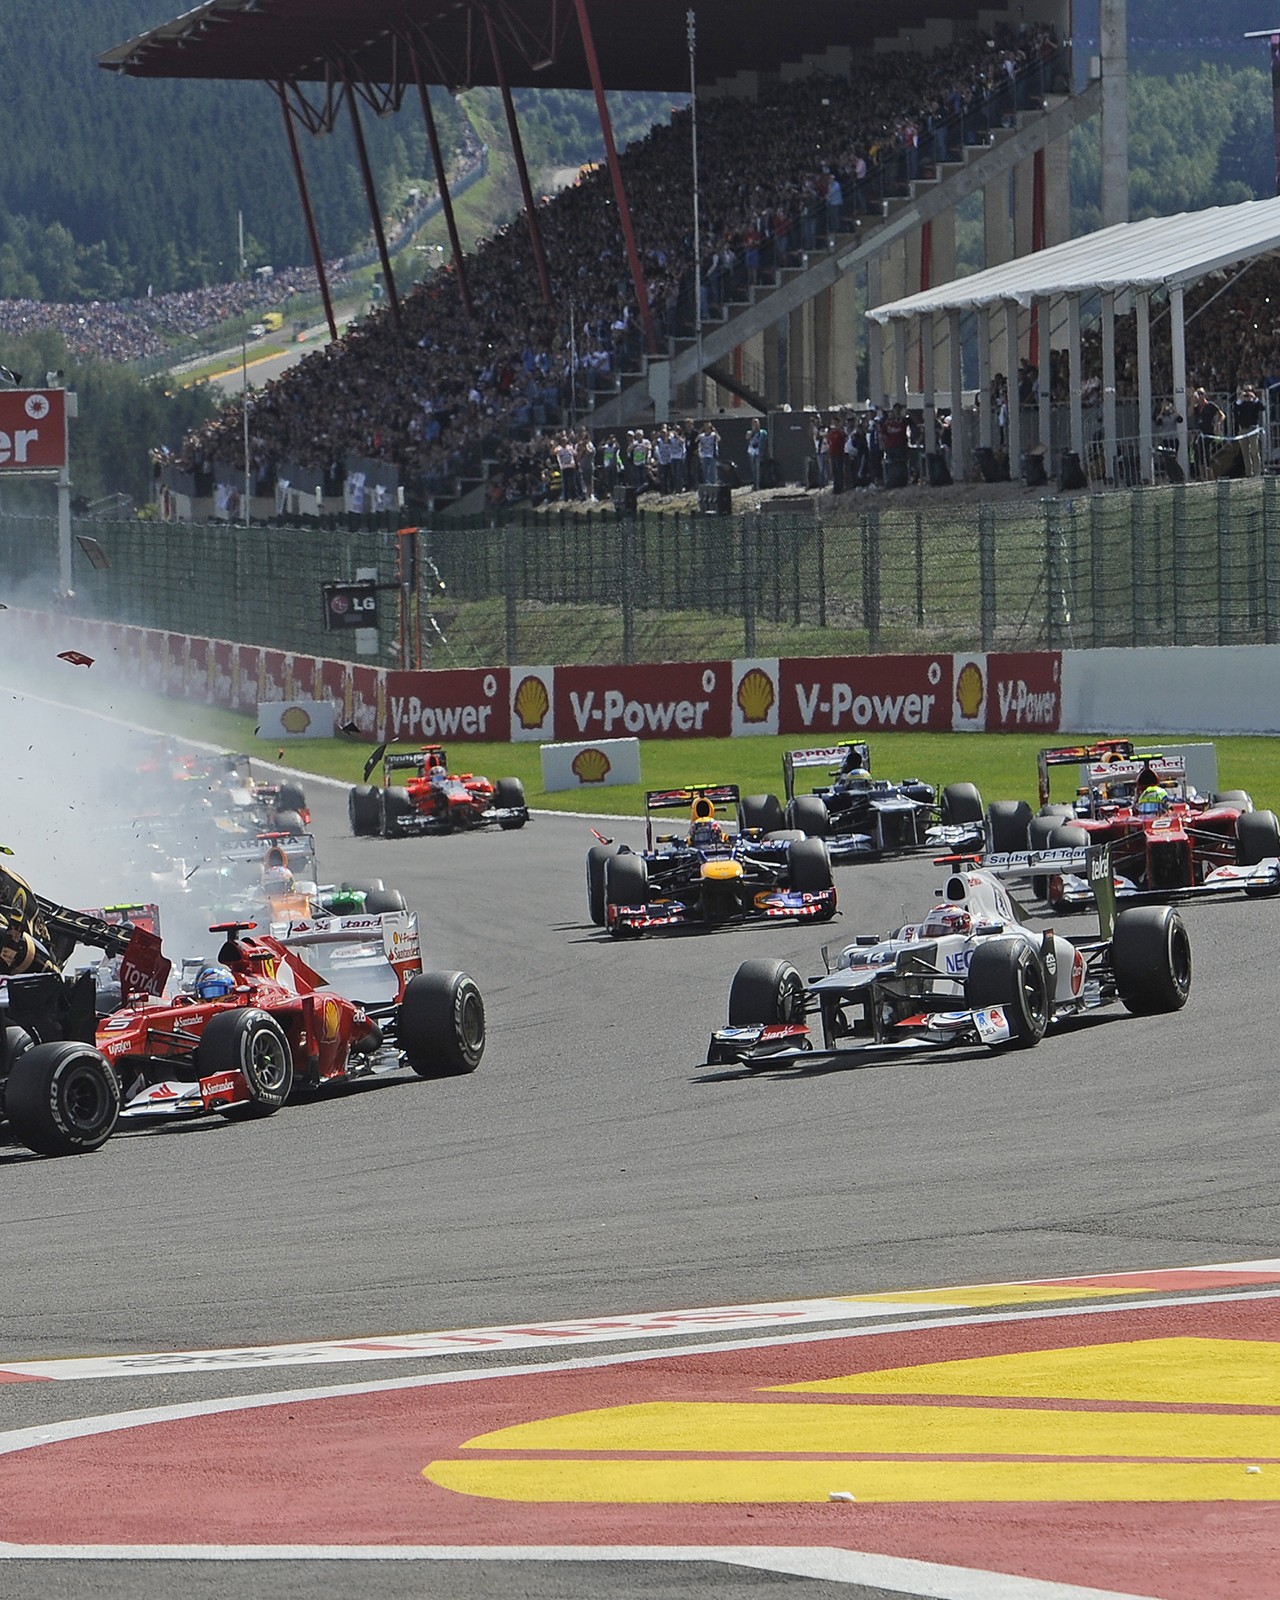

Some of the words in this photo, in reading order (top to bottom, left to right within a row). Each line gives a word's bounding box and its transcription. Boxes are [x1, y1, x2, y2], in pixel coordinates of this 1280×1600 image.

[353, 598, 375, 611] LG
[390, 696, 491, 736] V-Power
[569, 690, 709, 732] V-Power
[795, 683, 935, 726] V-Power
[997, 680, 1056, 724] V-Power
[990, 853, 1028, 864] Saube
[864, 951, 885, 964] 14
[124, 961, 160, 996] TOTAL
[104, 1017, 132, 1031] 5
[333, 1309, 806, 1351] UBS
